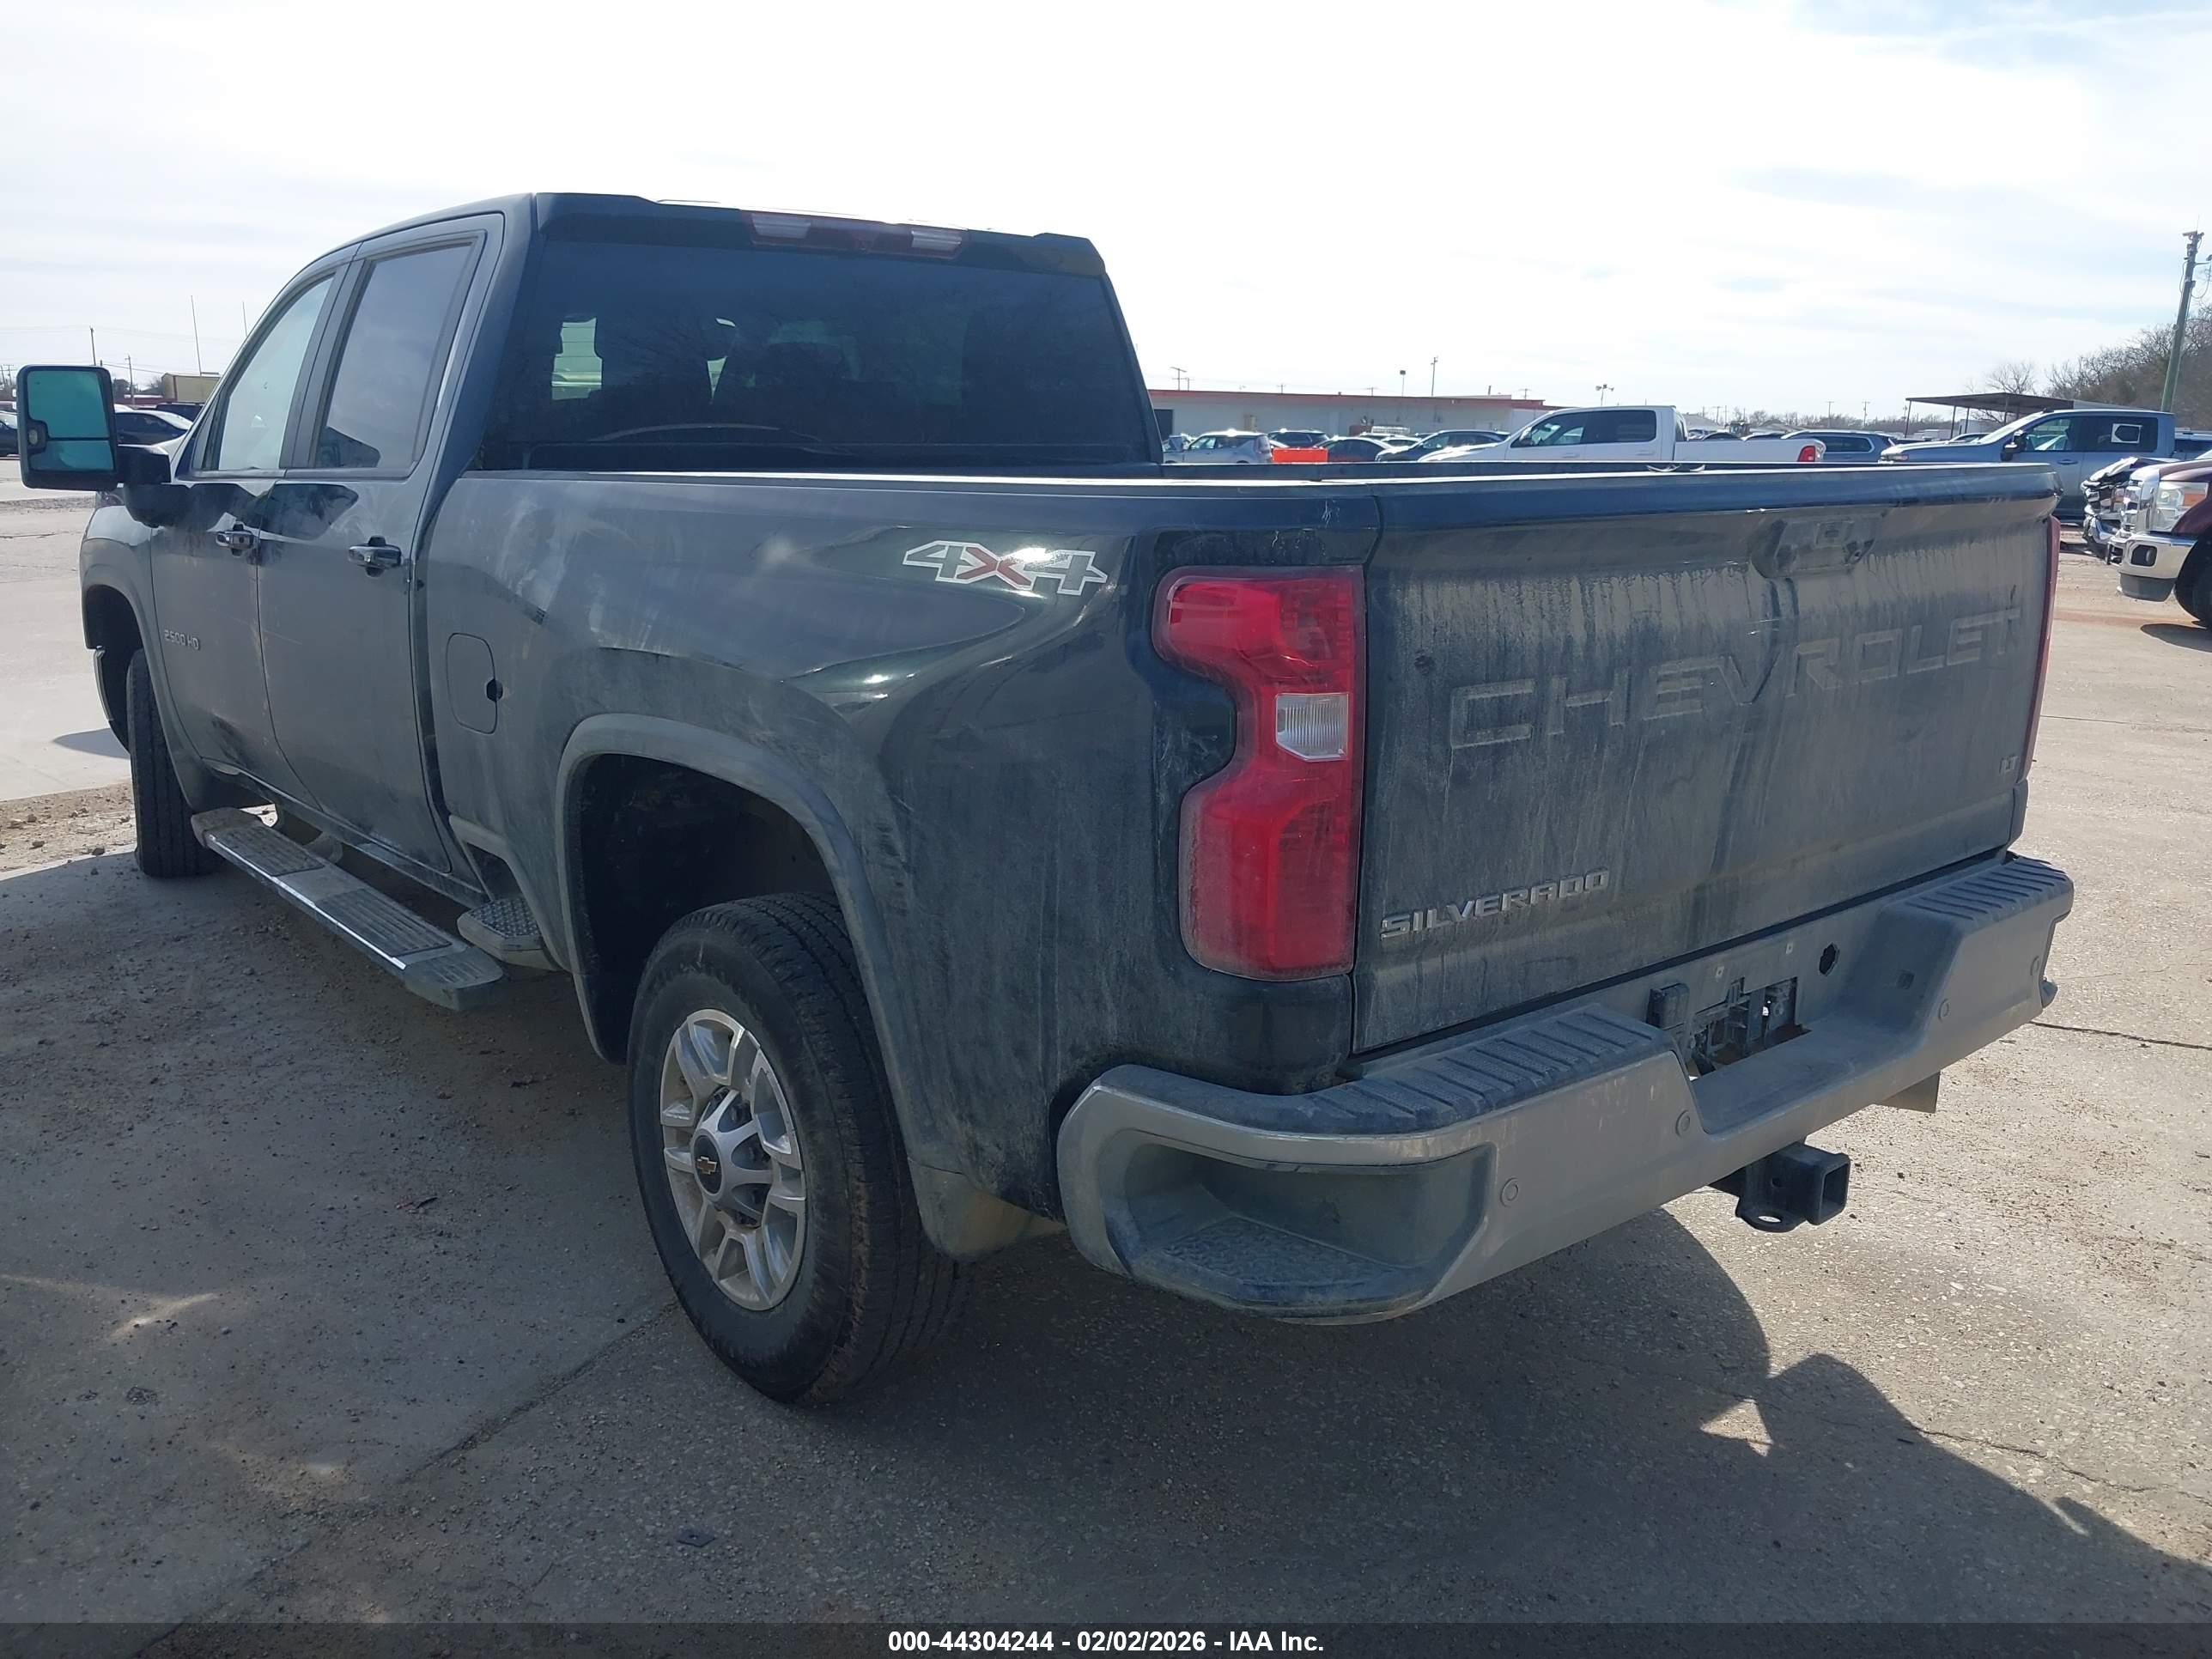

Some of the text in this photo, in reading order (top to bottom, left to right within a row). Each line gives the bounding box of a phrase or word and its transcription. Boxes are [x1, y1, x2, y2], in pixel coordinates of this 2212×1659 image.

[164, 629, 200, 650] 2500 HD
[1450, 608, 2021, 749] CHEVROLET
[1380, 867, 1608, 941] SILVERADO
